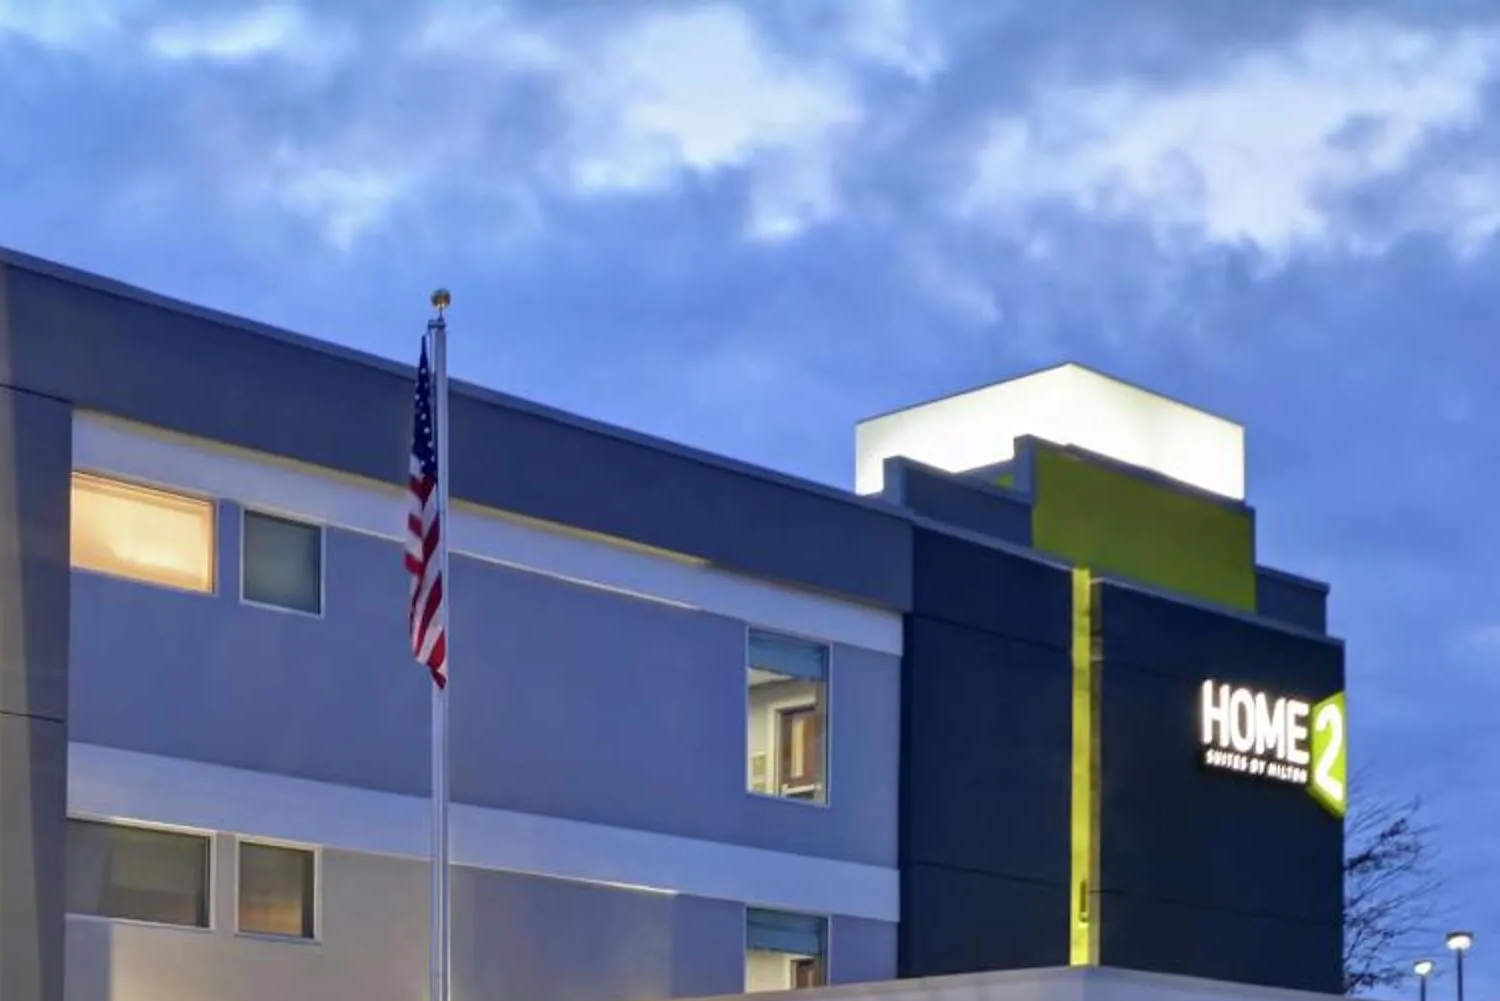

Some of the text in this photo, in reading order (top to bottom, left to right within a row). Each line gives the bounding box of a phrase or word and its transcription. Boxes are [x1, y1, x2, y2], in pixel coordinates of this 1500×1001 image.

[1202, 679, 1343, 801] HOME 2
[1206, 749, 1248, 772] SUITES
[1249, 758, 1266, 775] BY
